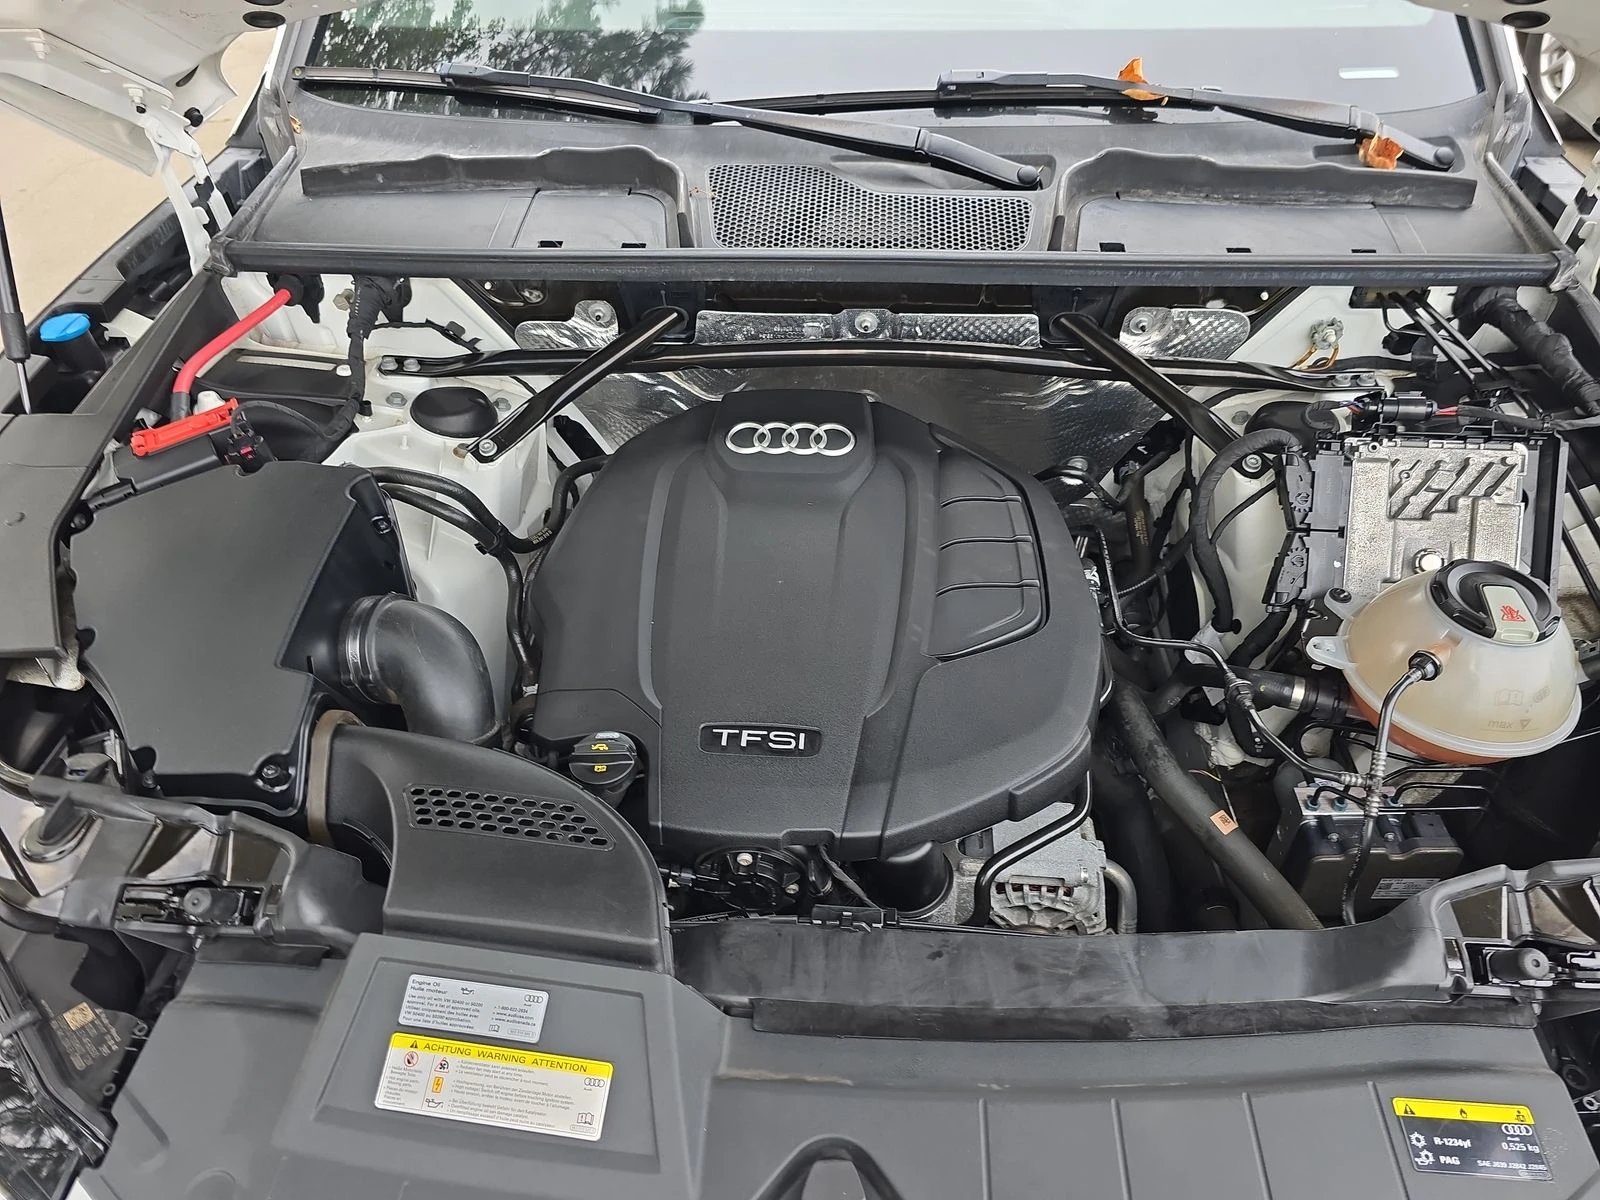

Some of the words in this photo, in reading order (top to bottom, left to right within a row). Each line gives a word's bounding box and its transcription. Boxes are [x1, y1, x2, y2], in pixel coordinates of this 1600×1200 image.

[1488, 720, 1514, 729] max
[712, 728, 806, 750] TFSI
[423, 1042, 471, 1056] ACHTUNG
[476, 1049, 526, 1063] WARNING
[531, 1057, 587, 1072] ATTENTION
[1432, 1136, 1472, 1148] R-1234yf
[1500, 1142, 1527, 1151] 0,525
[1527, 1144, 1540, 1153] kg
[1438, 1155, 1460, 1164] PAG
